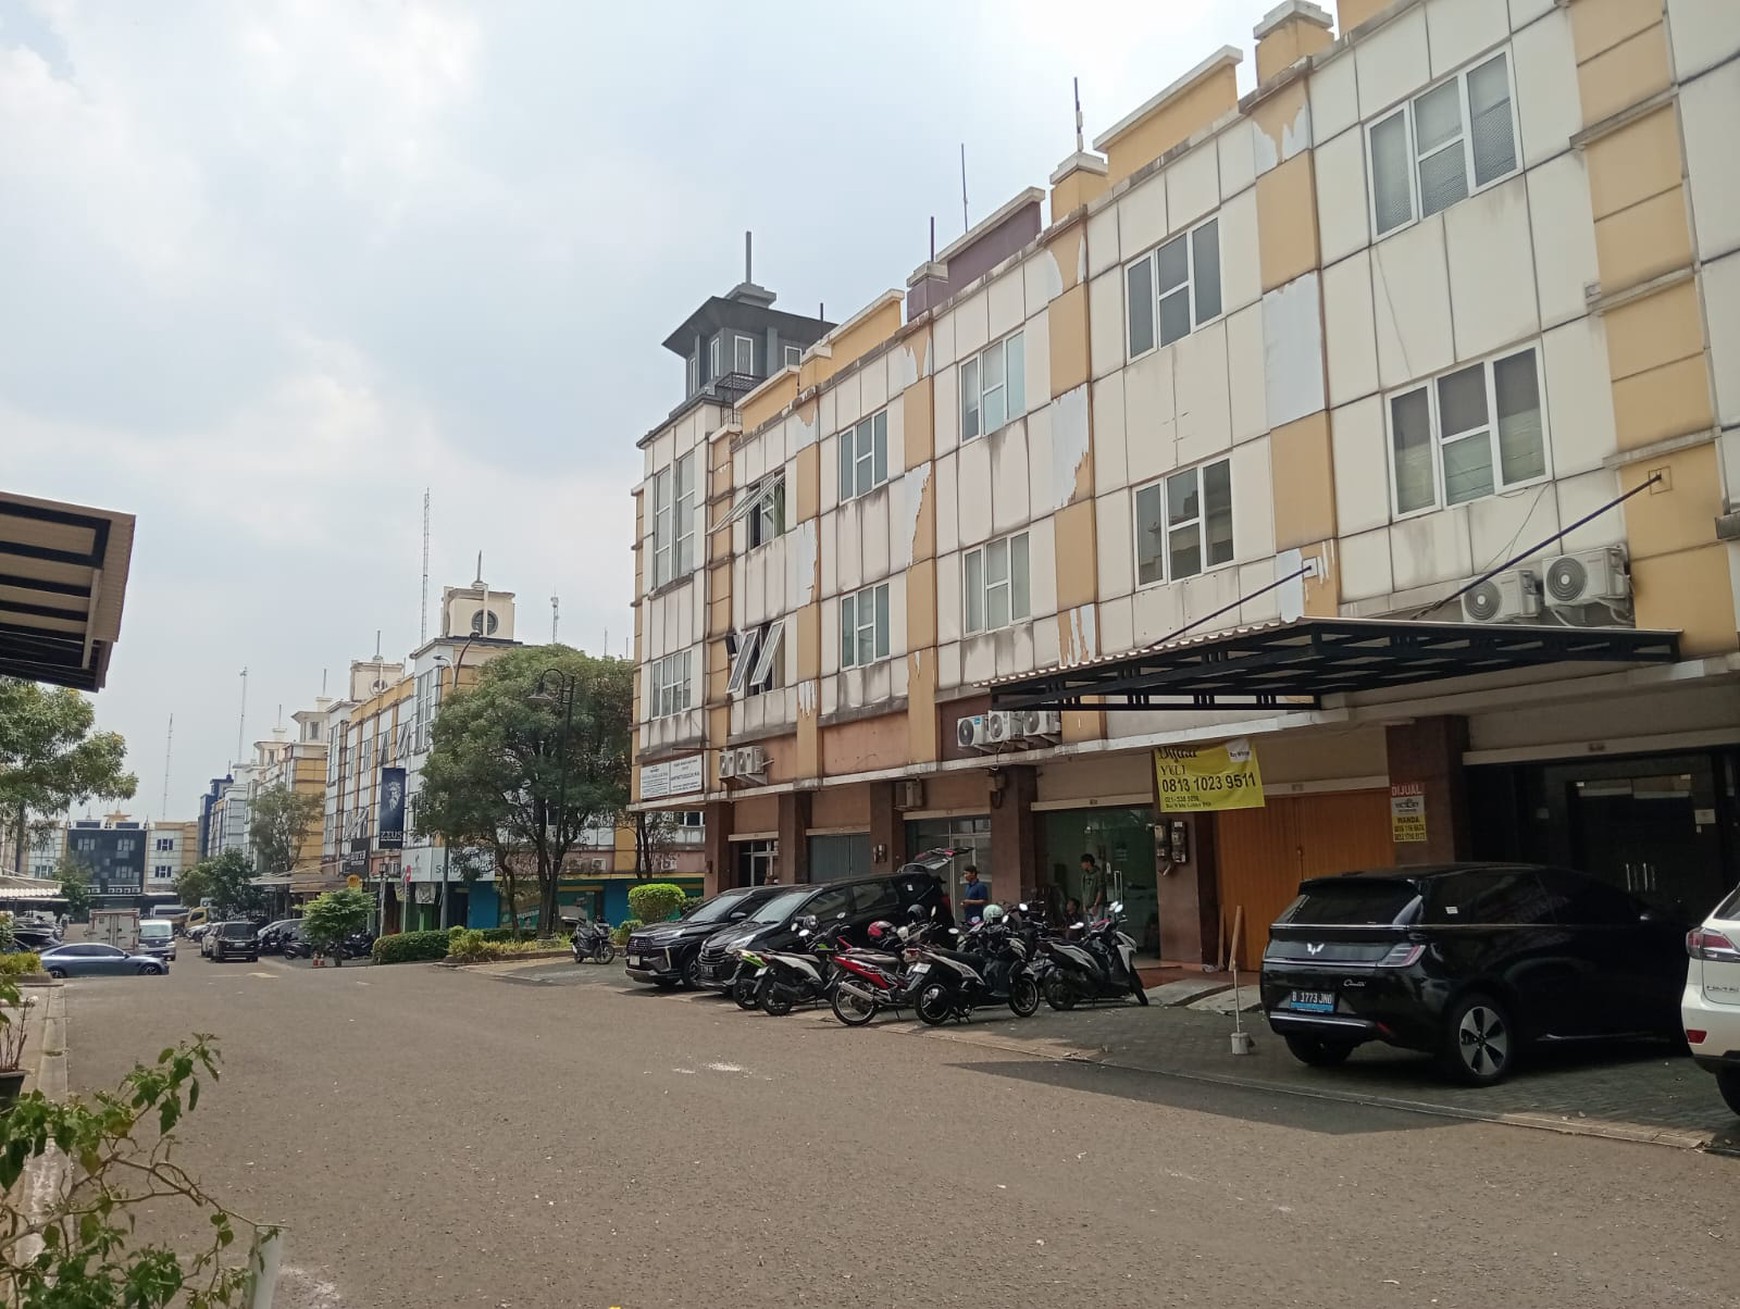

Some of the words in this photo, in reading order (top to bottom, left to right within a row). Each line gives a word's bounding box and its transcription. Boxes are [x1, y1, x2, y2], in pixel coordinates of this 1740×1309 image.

[1162, 778, 1190, 792] 0813
[1194, 775, 1223, 790] 1023
[1225, 772, 1256, 789] 9511
[1391, 784, 1422, 796] DIJUAL
[1300, 992, 1317, 1003] 1773
